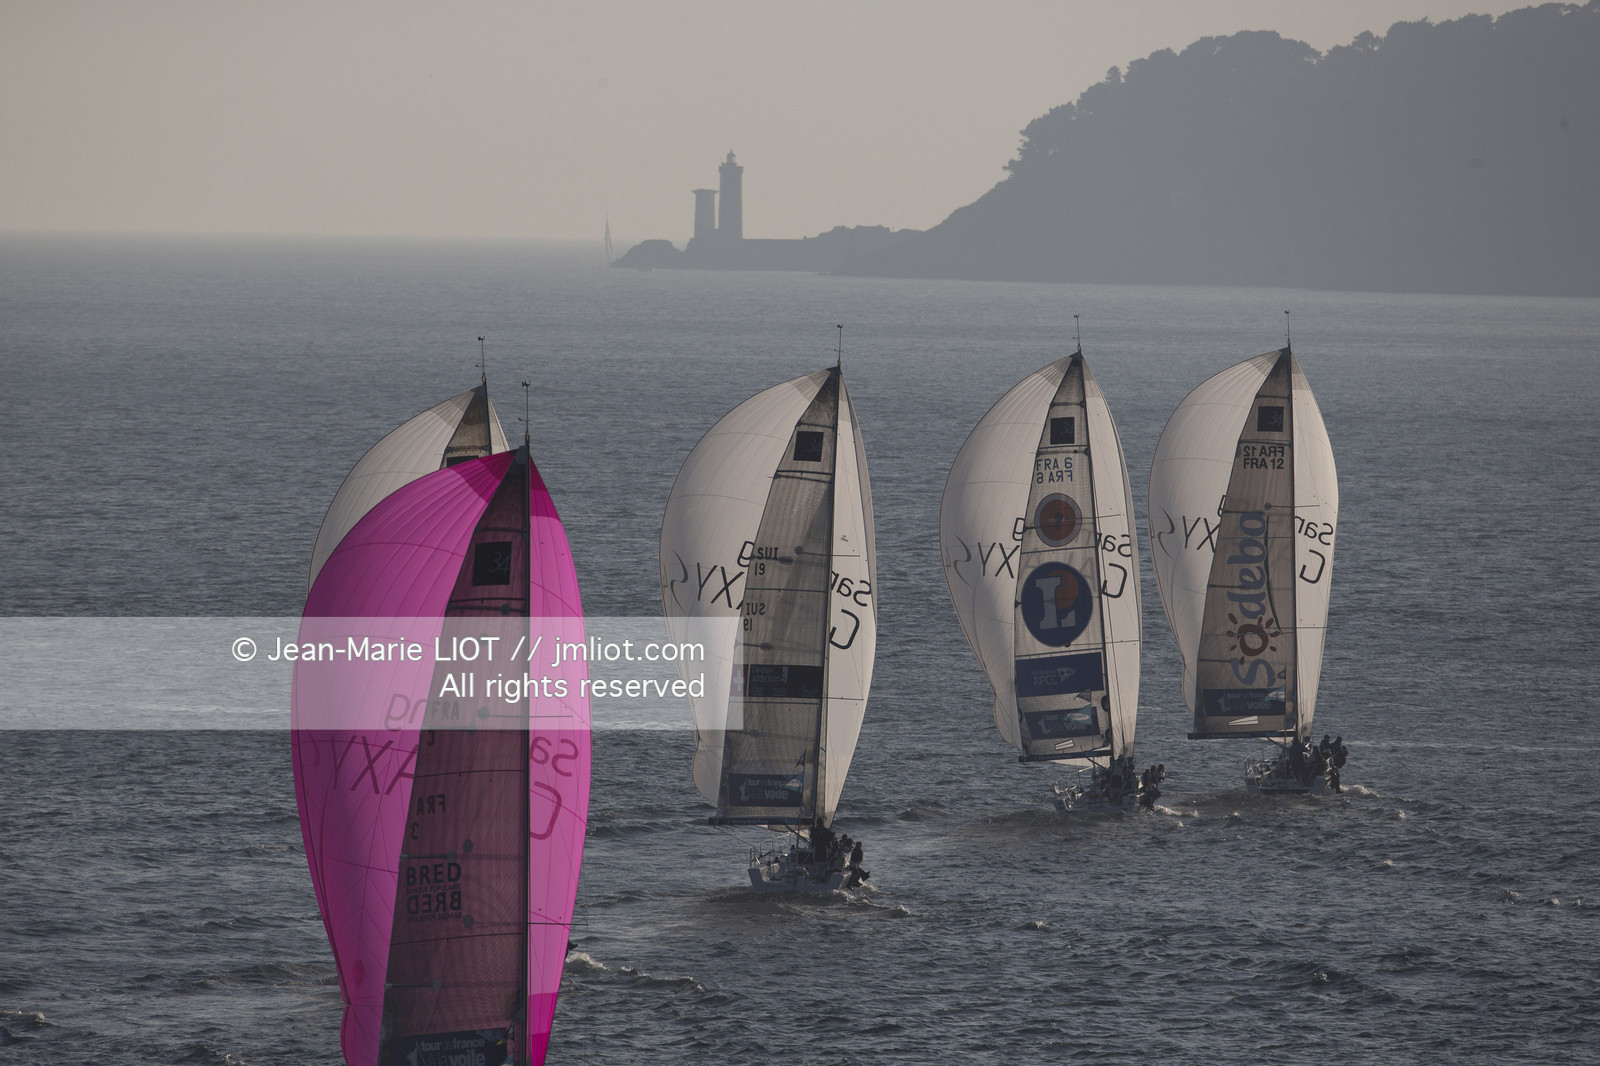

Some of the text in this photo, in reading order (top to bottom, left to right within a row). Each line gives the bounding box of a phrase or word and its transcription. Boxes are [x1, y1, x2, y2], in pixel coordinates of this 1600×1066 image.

[1036, 456, 1073, 472] FRA 6
[1243, 458, 1284, 470] FRA 12
[757, 546, 779, 560] SUI
[754, 563, 766, 576] 19
[1226, 511, 1276, 688] Sodebo
[406, 862, 462, 887] BRED
[421, 1040, 442, 1051] tour
[453, 1038, 486, 1050] france
[448, 1050, 487, 1066] voile
